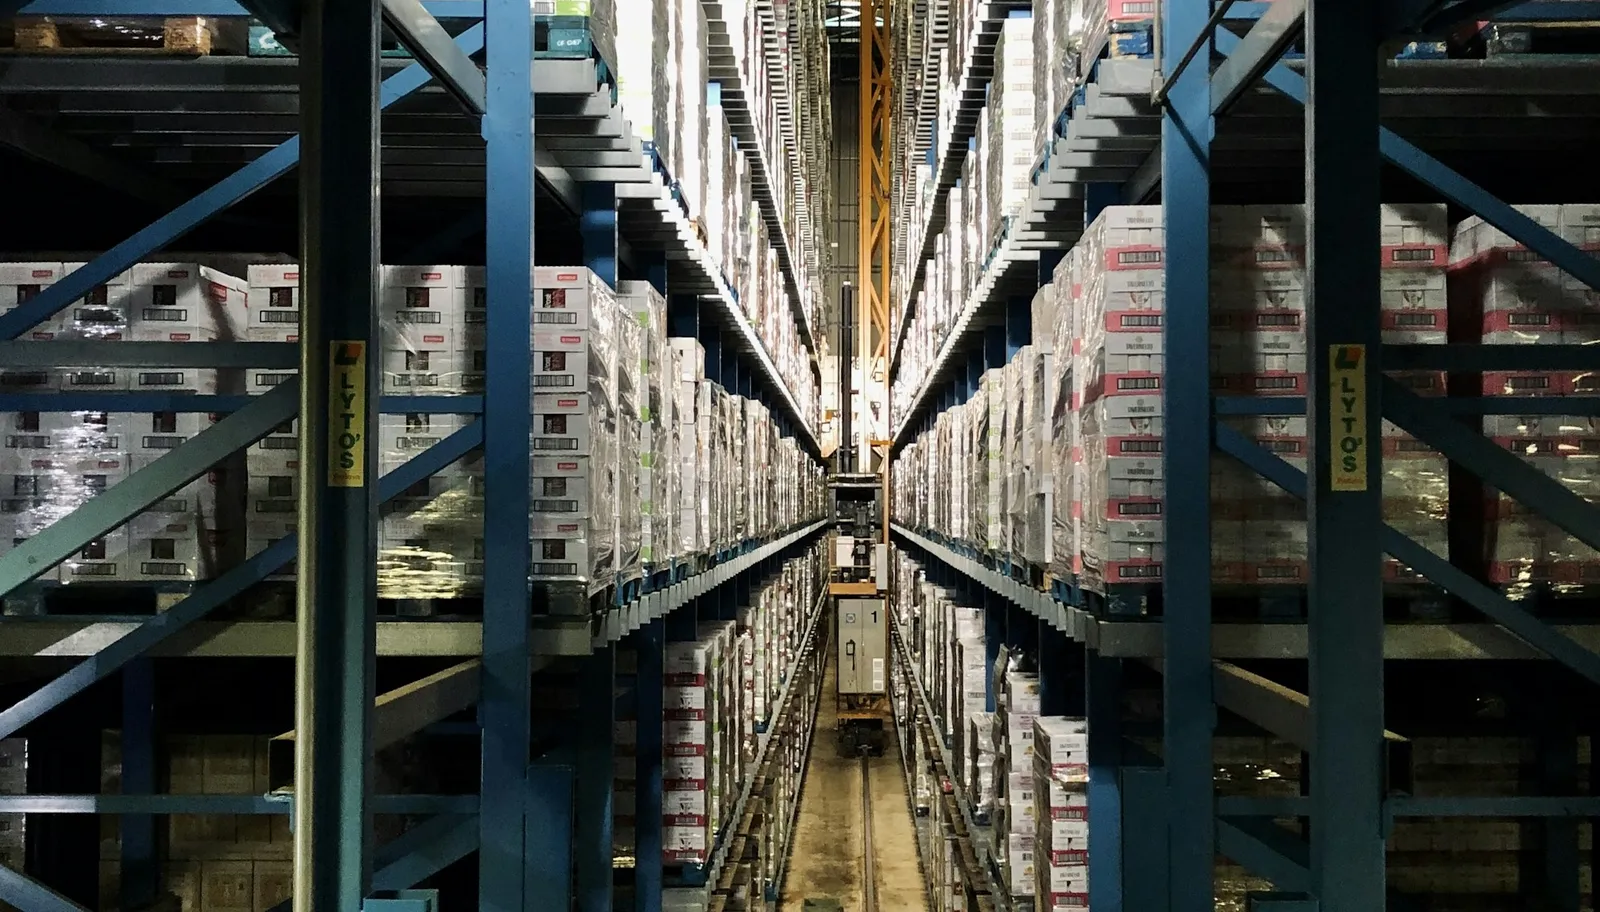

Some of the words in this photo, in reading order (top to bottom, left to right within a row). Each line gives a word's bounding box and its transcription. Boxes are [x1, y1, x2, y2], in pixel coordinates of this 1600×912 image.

[338, 372, 360, 469] LYTO'S
[1340, 377, 1363, 473] LYTO'S
[870, 610, 877, 624] 1
